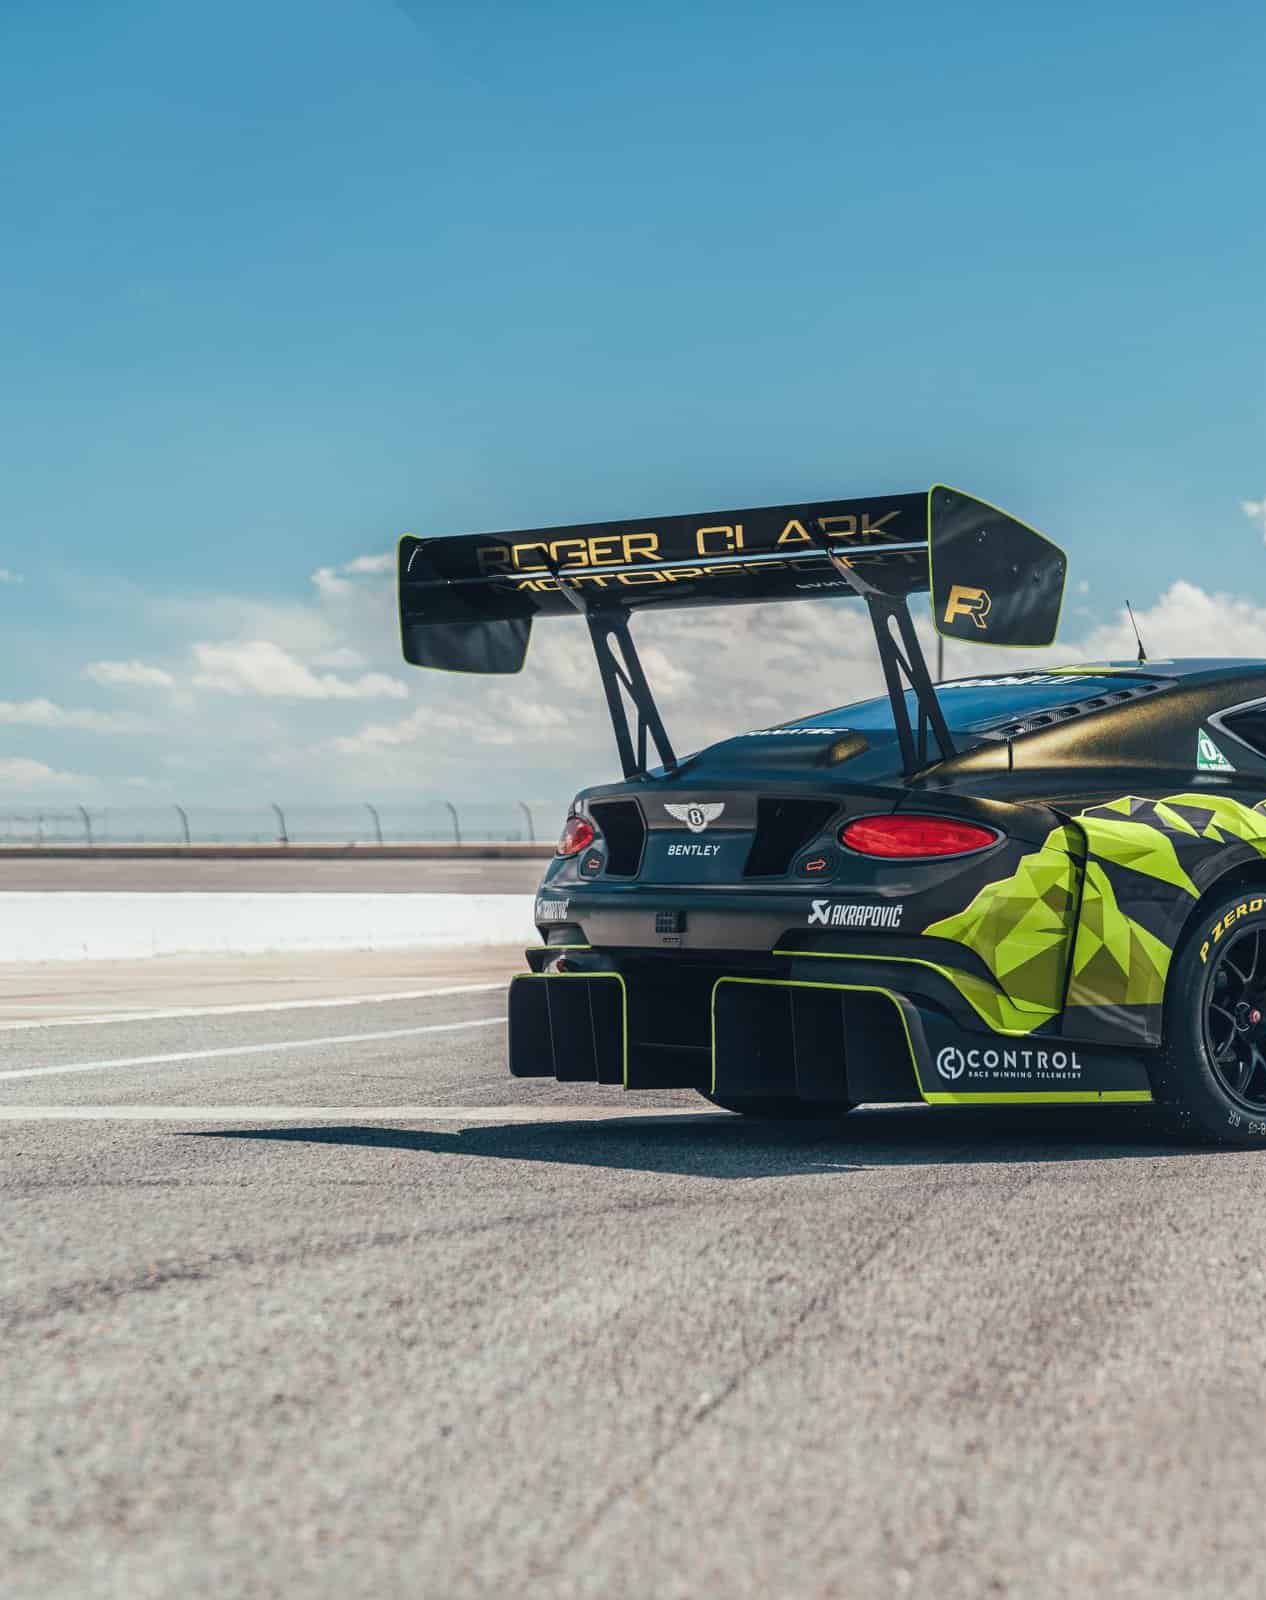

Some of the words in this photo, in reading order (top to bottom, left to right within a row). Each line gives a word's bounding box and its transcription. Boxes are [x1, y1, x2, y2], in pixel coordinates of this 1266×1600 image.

[667, 844, 721, 856] BENTLEY
[1211, 898, 1264, 943] ZERO
[967, 1050, 1081, 1069] CONTROL
[993, 1071, 1032, 1079] WINNING
